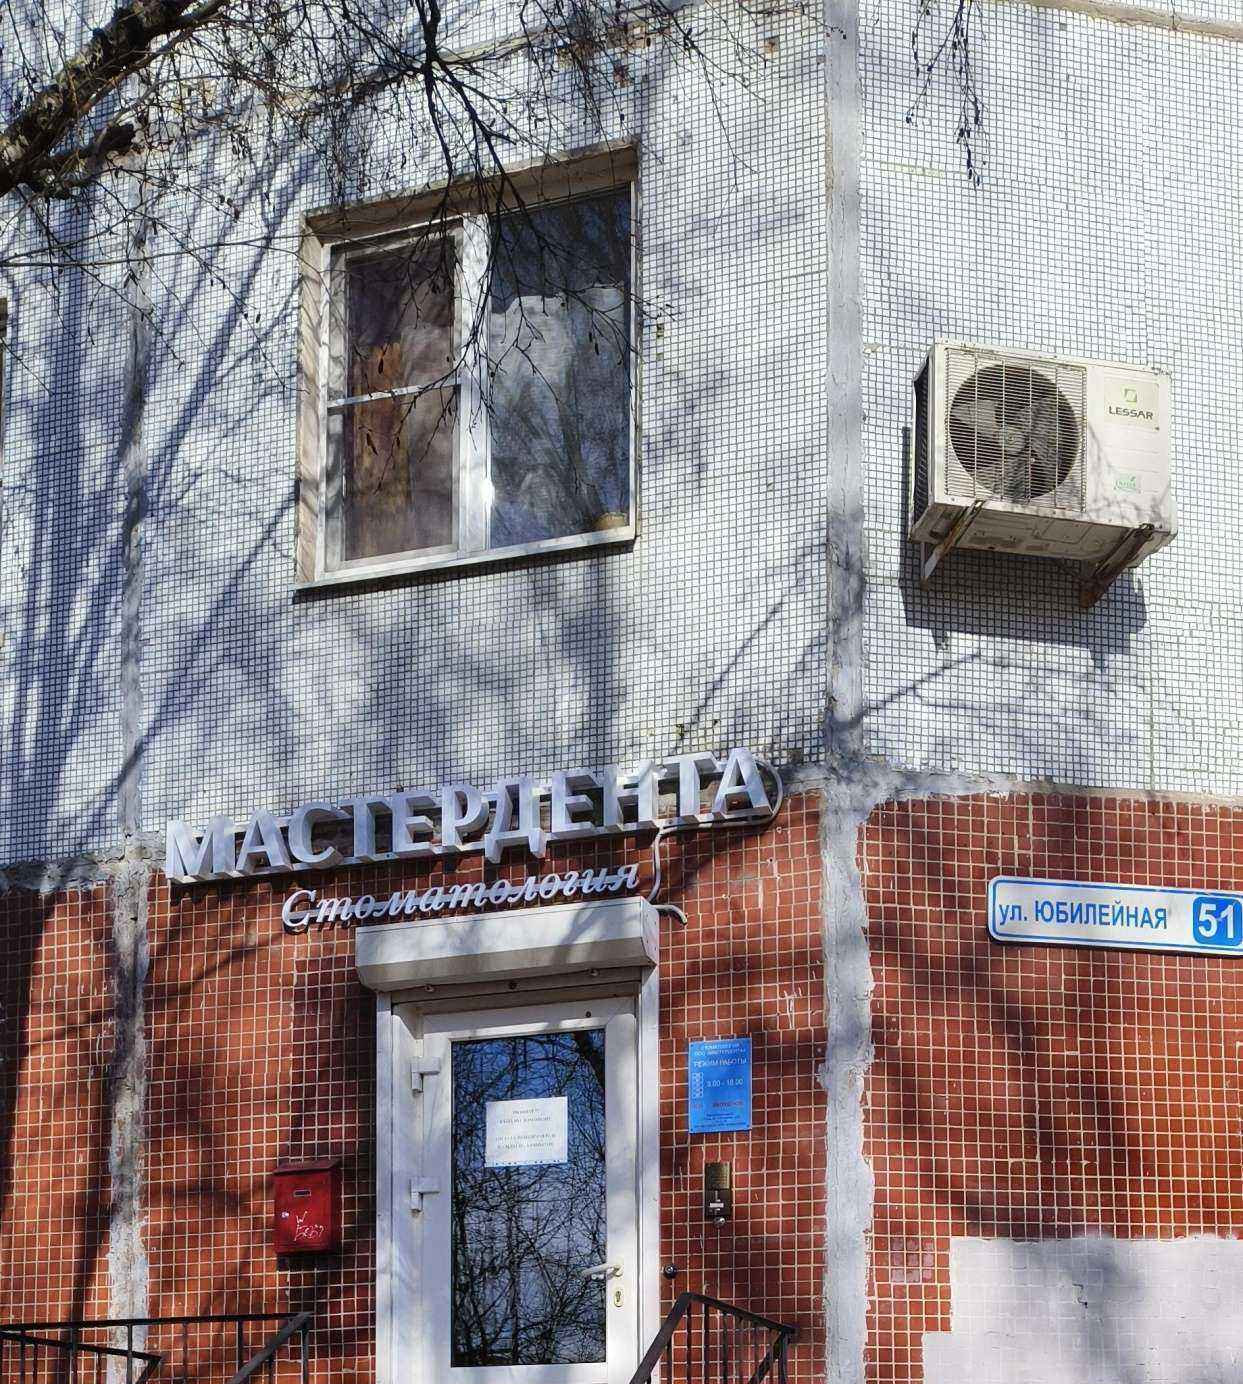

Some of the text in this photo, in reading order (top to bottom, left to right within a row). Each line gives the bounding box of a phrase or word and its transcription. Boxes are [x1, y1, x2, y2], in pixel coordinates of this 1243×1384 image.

[1108, 407, 1154, 420] LESSAR
[165, 747, 774, 883] МАСТЕРДЕНТА
[281, 861, 640, 934] Стоматология
[998, 899, 1235, 939] ул. ЮБИЛЕЙНАЯ 51
